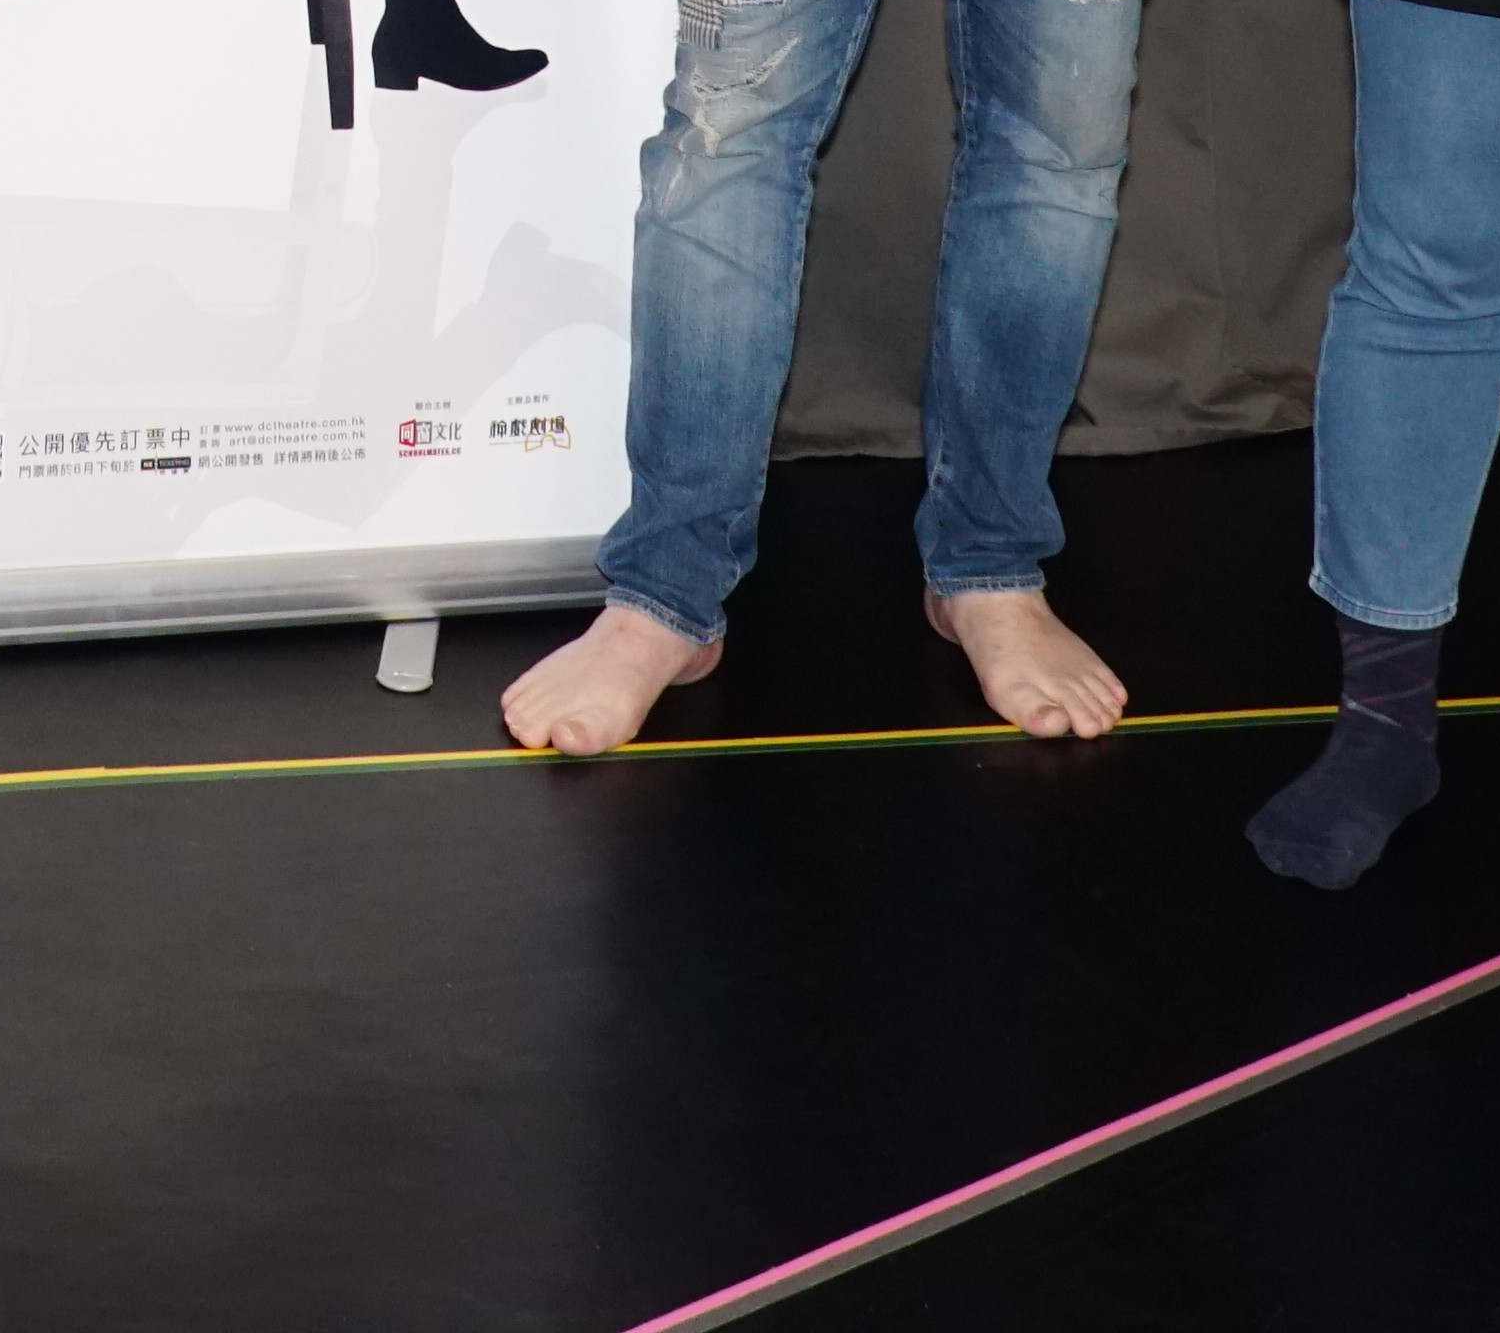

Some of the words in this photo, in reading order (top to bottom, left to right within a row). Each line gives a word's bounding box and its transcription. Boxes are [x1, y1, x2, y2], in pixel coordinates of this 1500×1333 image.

[224, 416, 366, 434] www.dctheatre.com.hk
[18, 426, 191, 456] 公開優先訂票中
